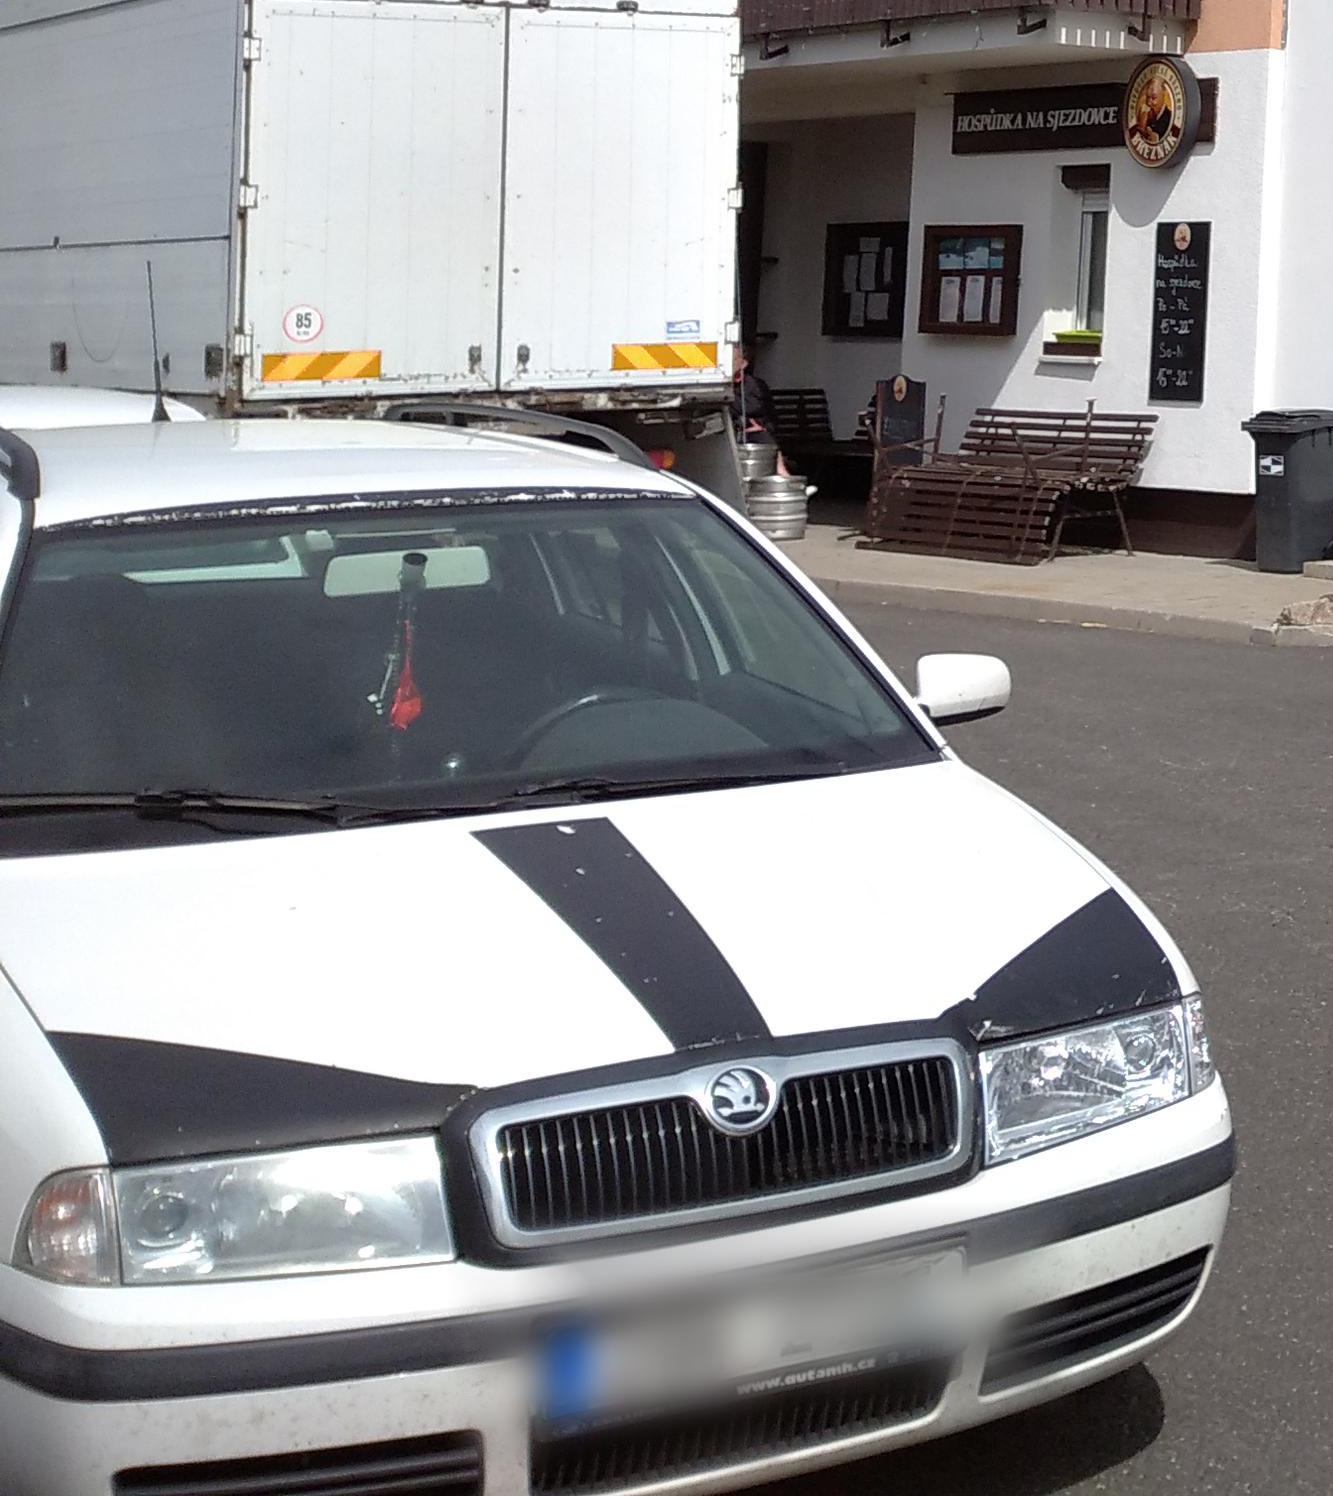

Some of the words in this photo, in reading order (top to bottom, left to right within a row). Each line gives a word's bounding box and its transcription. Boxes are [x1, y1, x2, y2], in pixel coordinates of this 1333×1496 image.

[956, 108, 1023, 133] HOSPŮDKA
[1026, 111, 1045, 129] NA
[1046, 106, 1119, 132] SJEZDOVCE
[295, 312, 312, 329] 85
